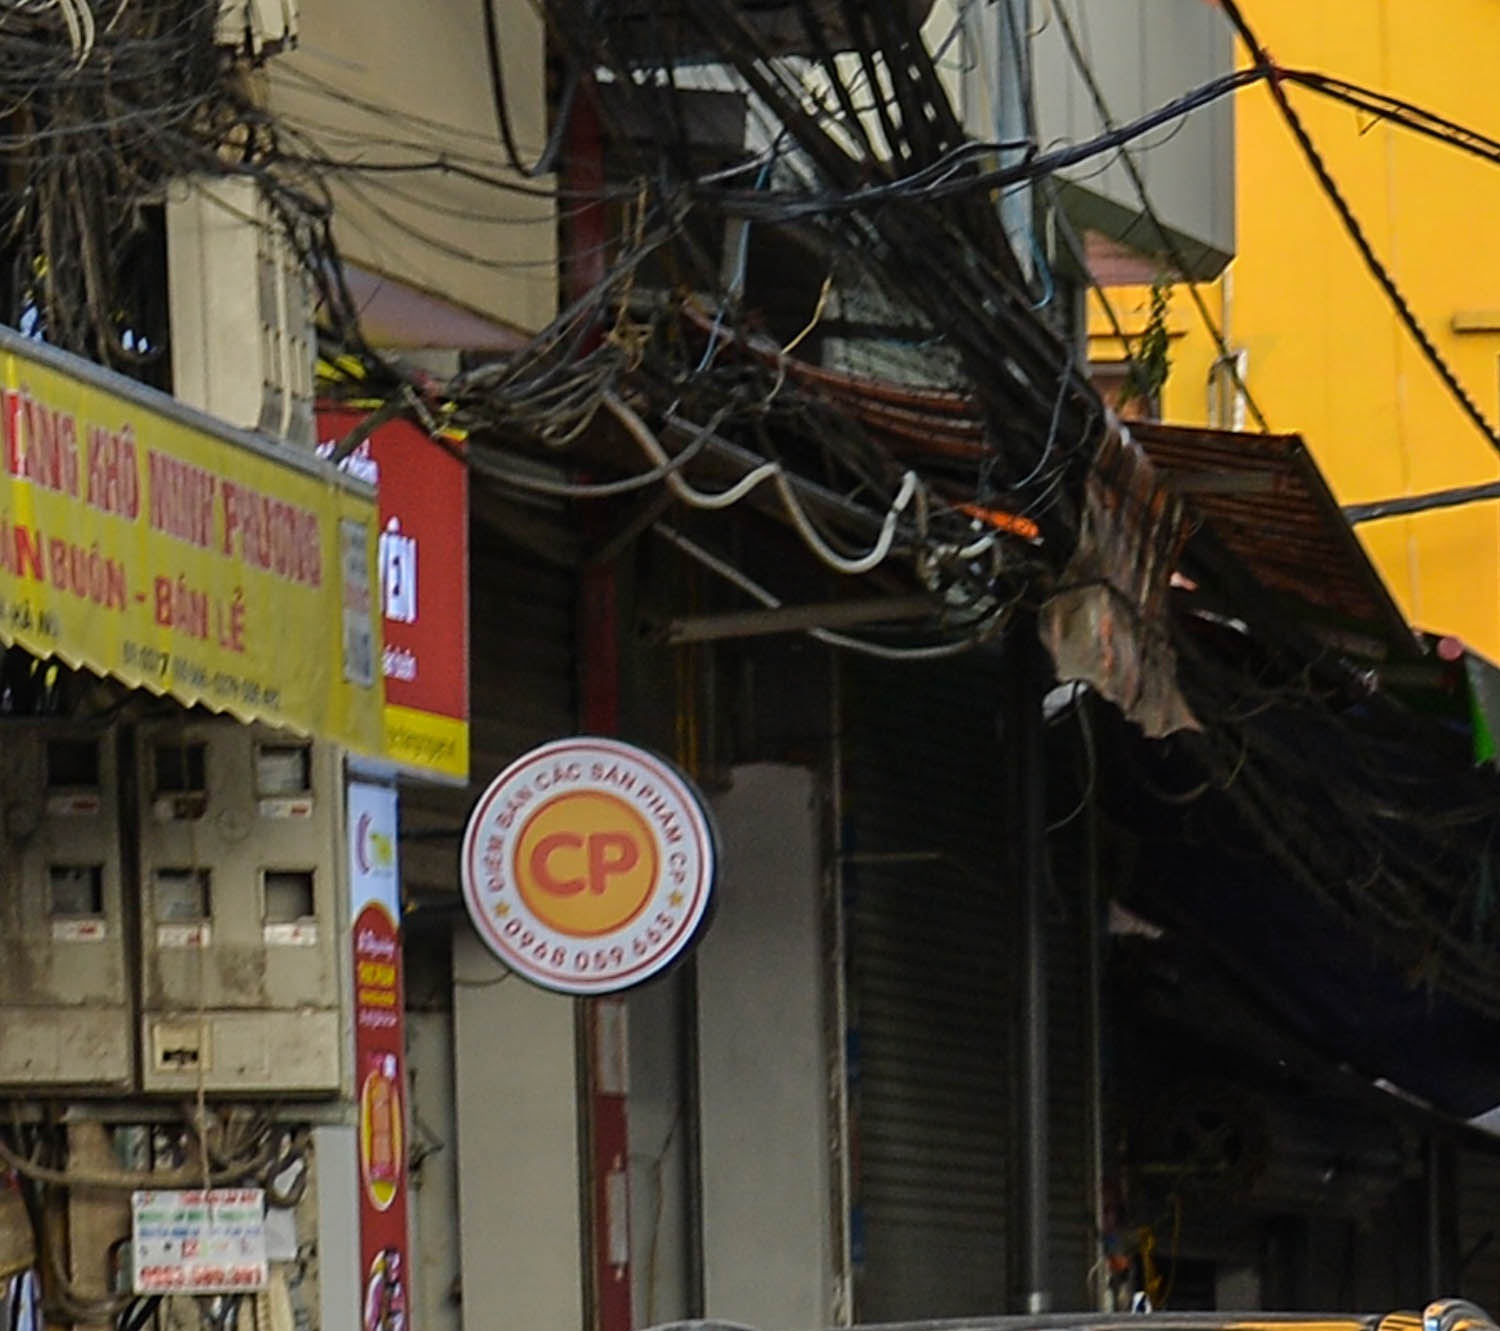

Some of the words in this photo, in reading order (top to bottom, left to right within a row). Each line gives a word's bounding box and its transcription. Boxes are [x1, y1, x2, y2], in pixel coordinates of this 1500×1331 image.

[155, 571, 209, 642] BÁN
[535, 762, 583, 792] CÁC
[529, 831, 641, 896] CP
[504, 917, 569, 967] 0968
